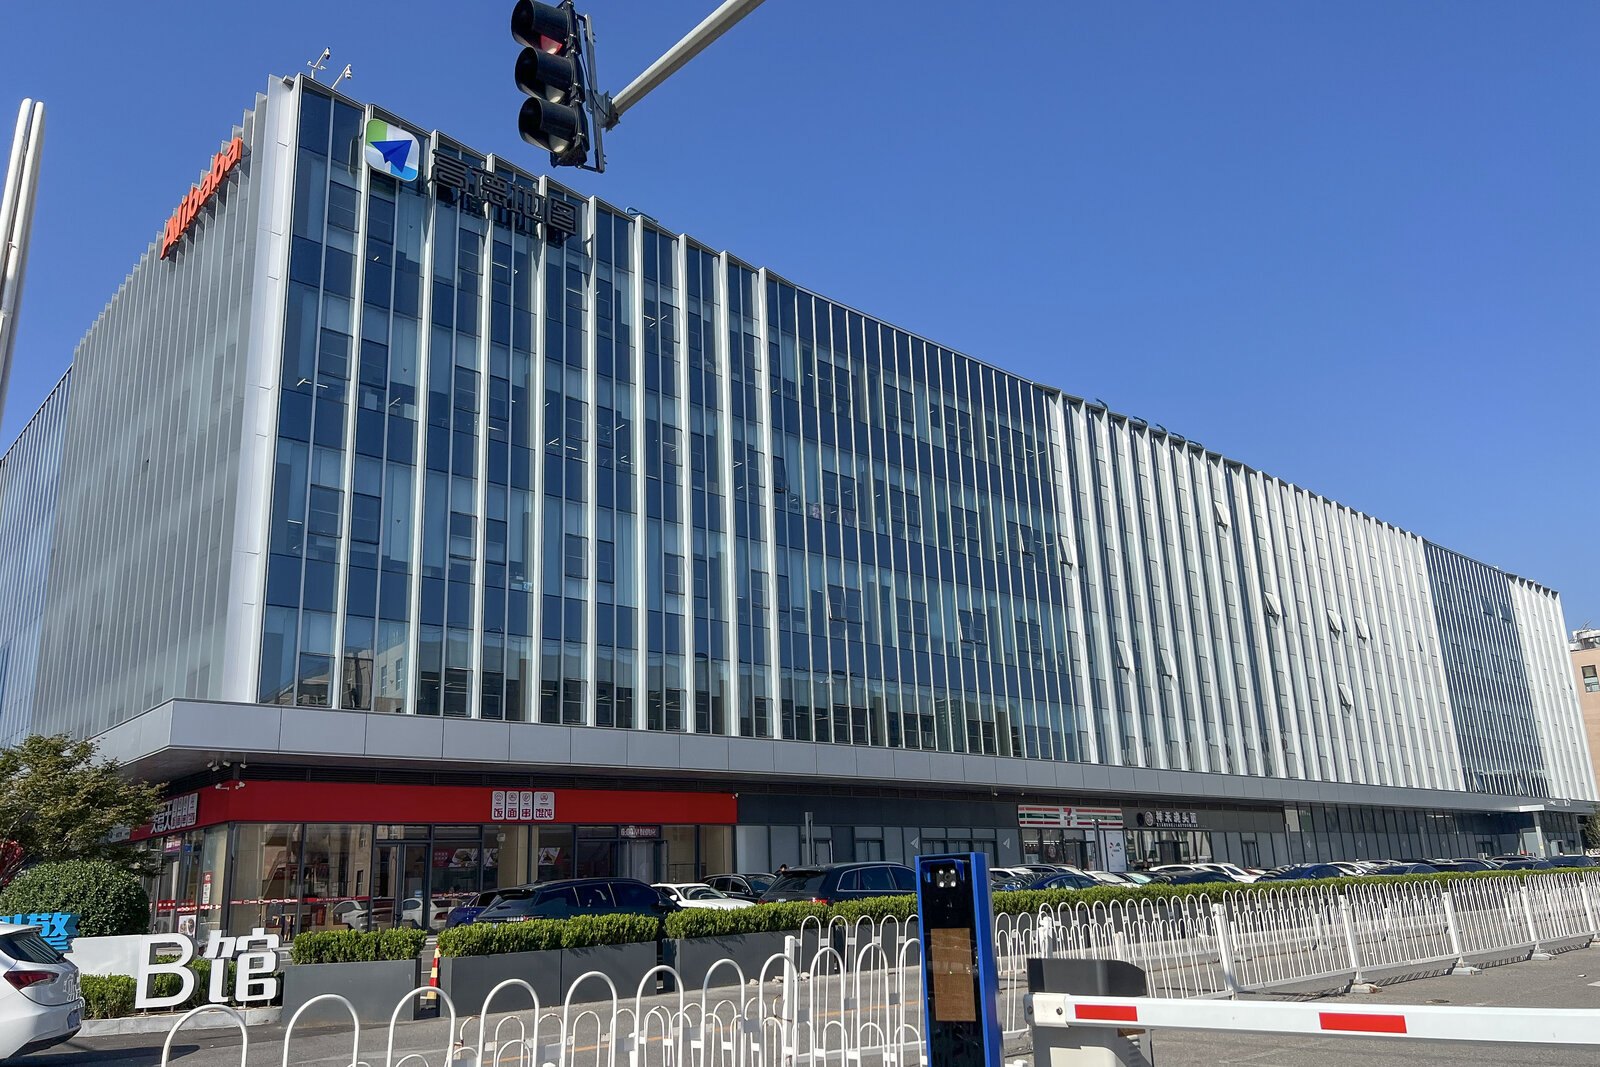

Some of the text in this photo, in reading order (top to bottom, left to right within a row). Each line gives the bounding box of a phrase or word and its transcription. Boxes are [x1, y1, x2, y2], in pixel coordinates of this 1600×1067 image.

[431, 149, 578, 238] 高德地图
[493, 808, 504, 818] 饭
[507, 808, 518, 818] 面
[521, 808, 531, 818] 串
